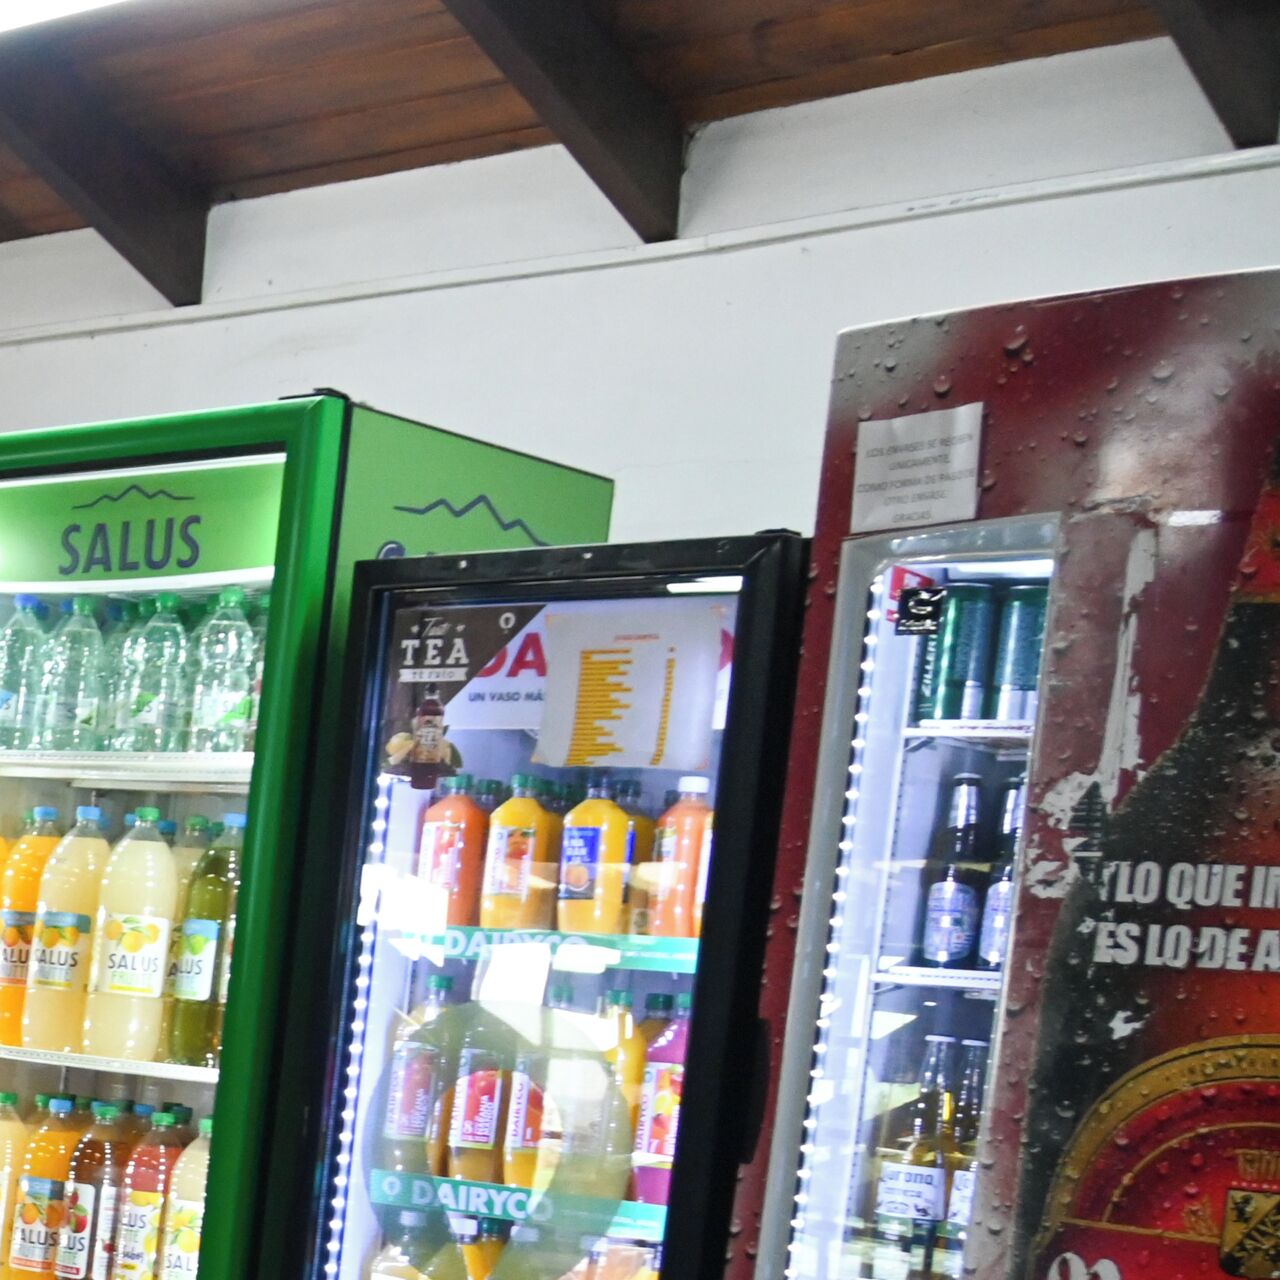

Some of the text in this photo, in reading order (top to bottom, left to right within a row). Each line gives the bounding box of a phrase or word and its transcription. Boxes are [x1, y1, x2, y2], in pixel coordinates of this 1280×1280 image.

[59, 514, 201, 577] SALUS
[401, 638, 469, 665] TEA
[469, 690, 545, 702] UN VASO MÁ
[1115, 860, 1162, 904] LO
[1165, 862, 1247, 910] QUE
[107, 953, 160, 973] SALUS
[1093, 921, 1141, 966] ES
[1144, 924, 1192, 969] LO
[1196, 926, 1251, 971] DE
[413, 1180, 553, 1222] DAIRYCO
[164, 1252, 192, 1272] SAL
